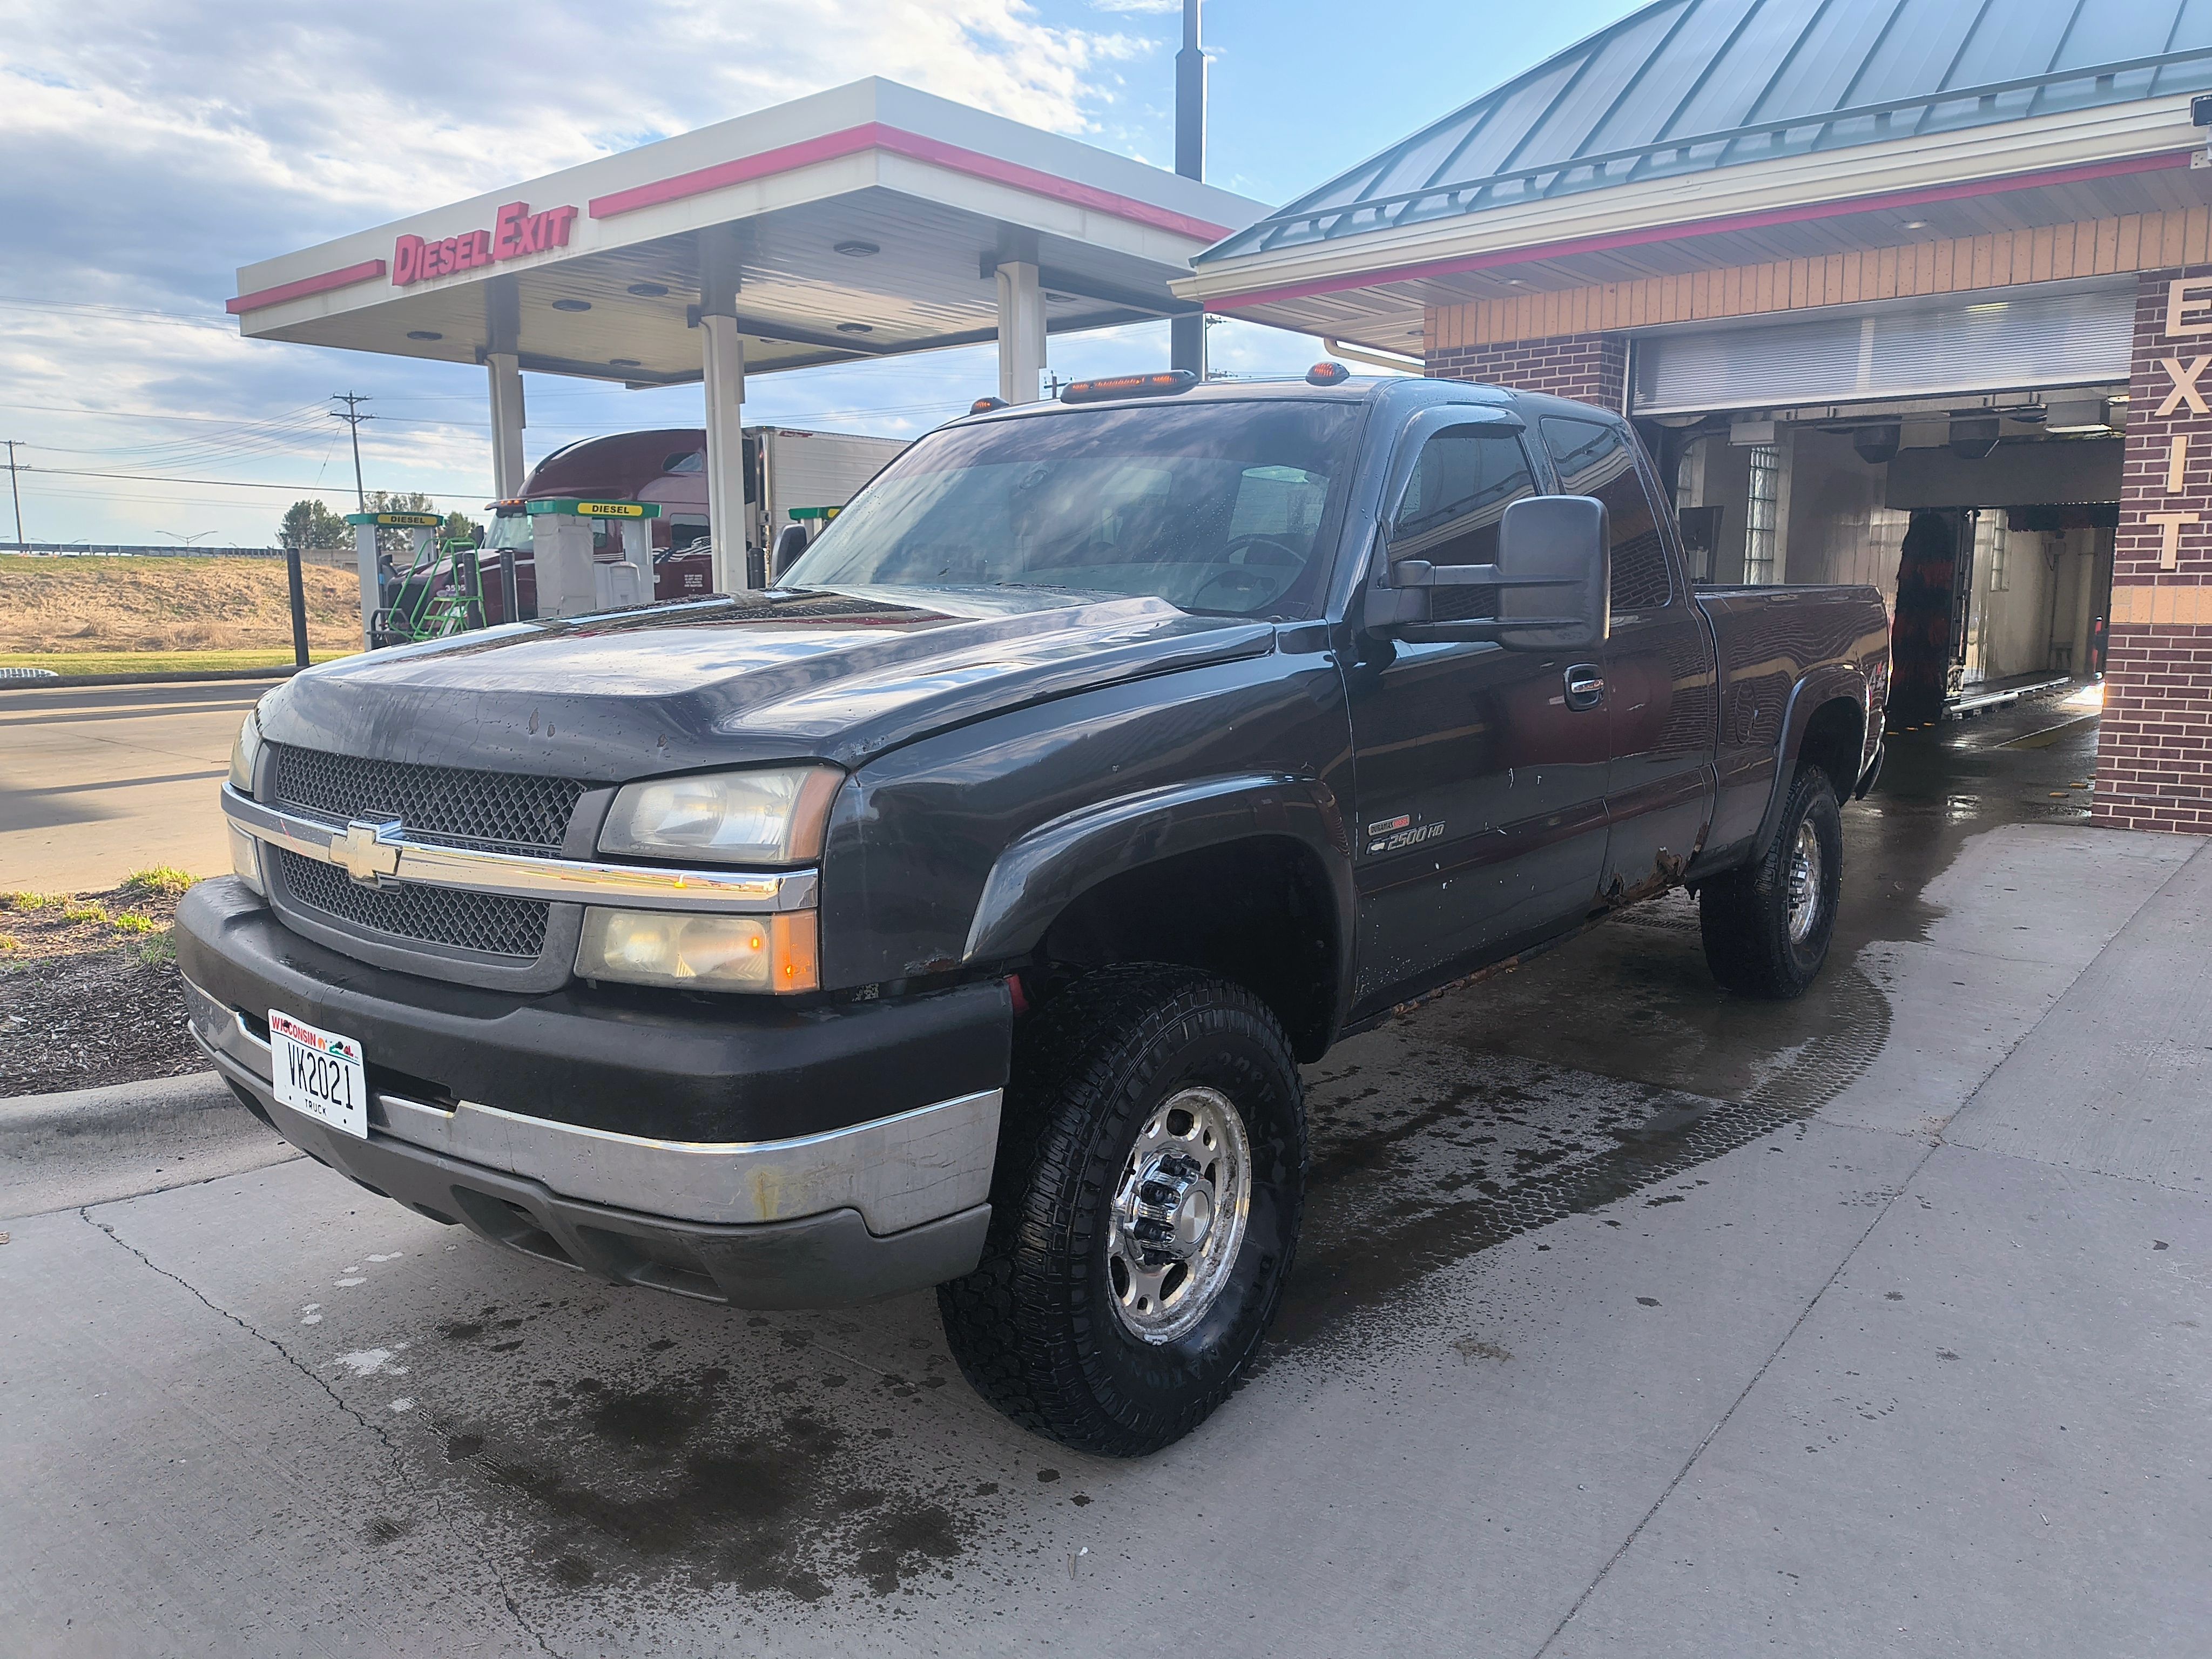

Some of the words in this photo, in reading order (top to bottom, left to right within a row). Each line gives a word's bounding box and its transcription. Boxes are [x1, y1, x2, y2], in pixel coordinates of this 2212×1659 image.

[392, 229, 494, 286] DIESEL
[493, 200, 579, 261] EXIT
[2146, 276, 2212, 570] EXIT
[390, 516, 426, 524] DIESEL
[592, 504, 630, 514] DIESEL
[1387, 827, 1427, 851] 2500
[1427, 824, 1445, 839] HD
[287, 1041, 354, 1111] VK2021
[304, 1098, 327, 1116] TRUCK
